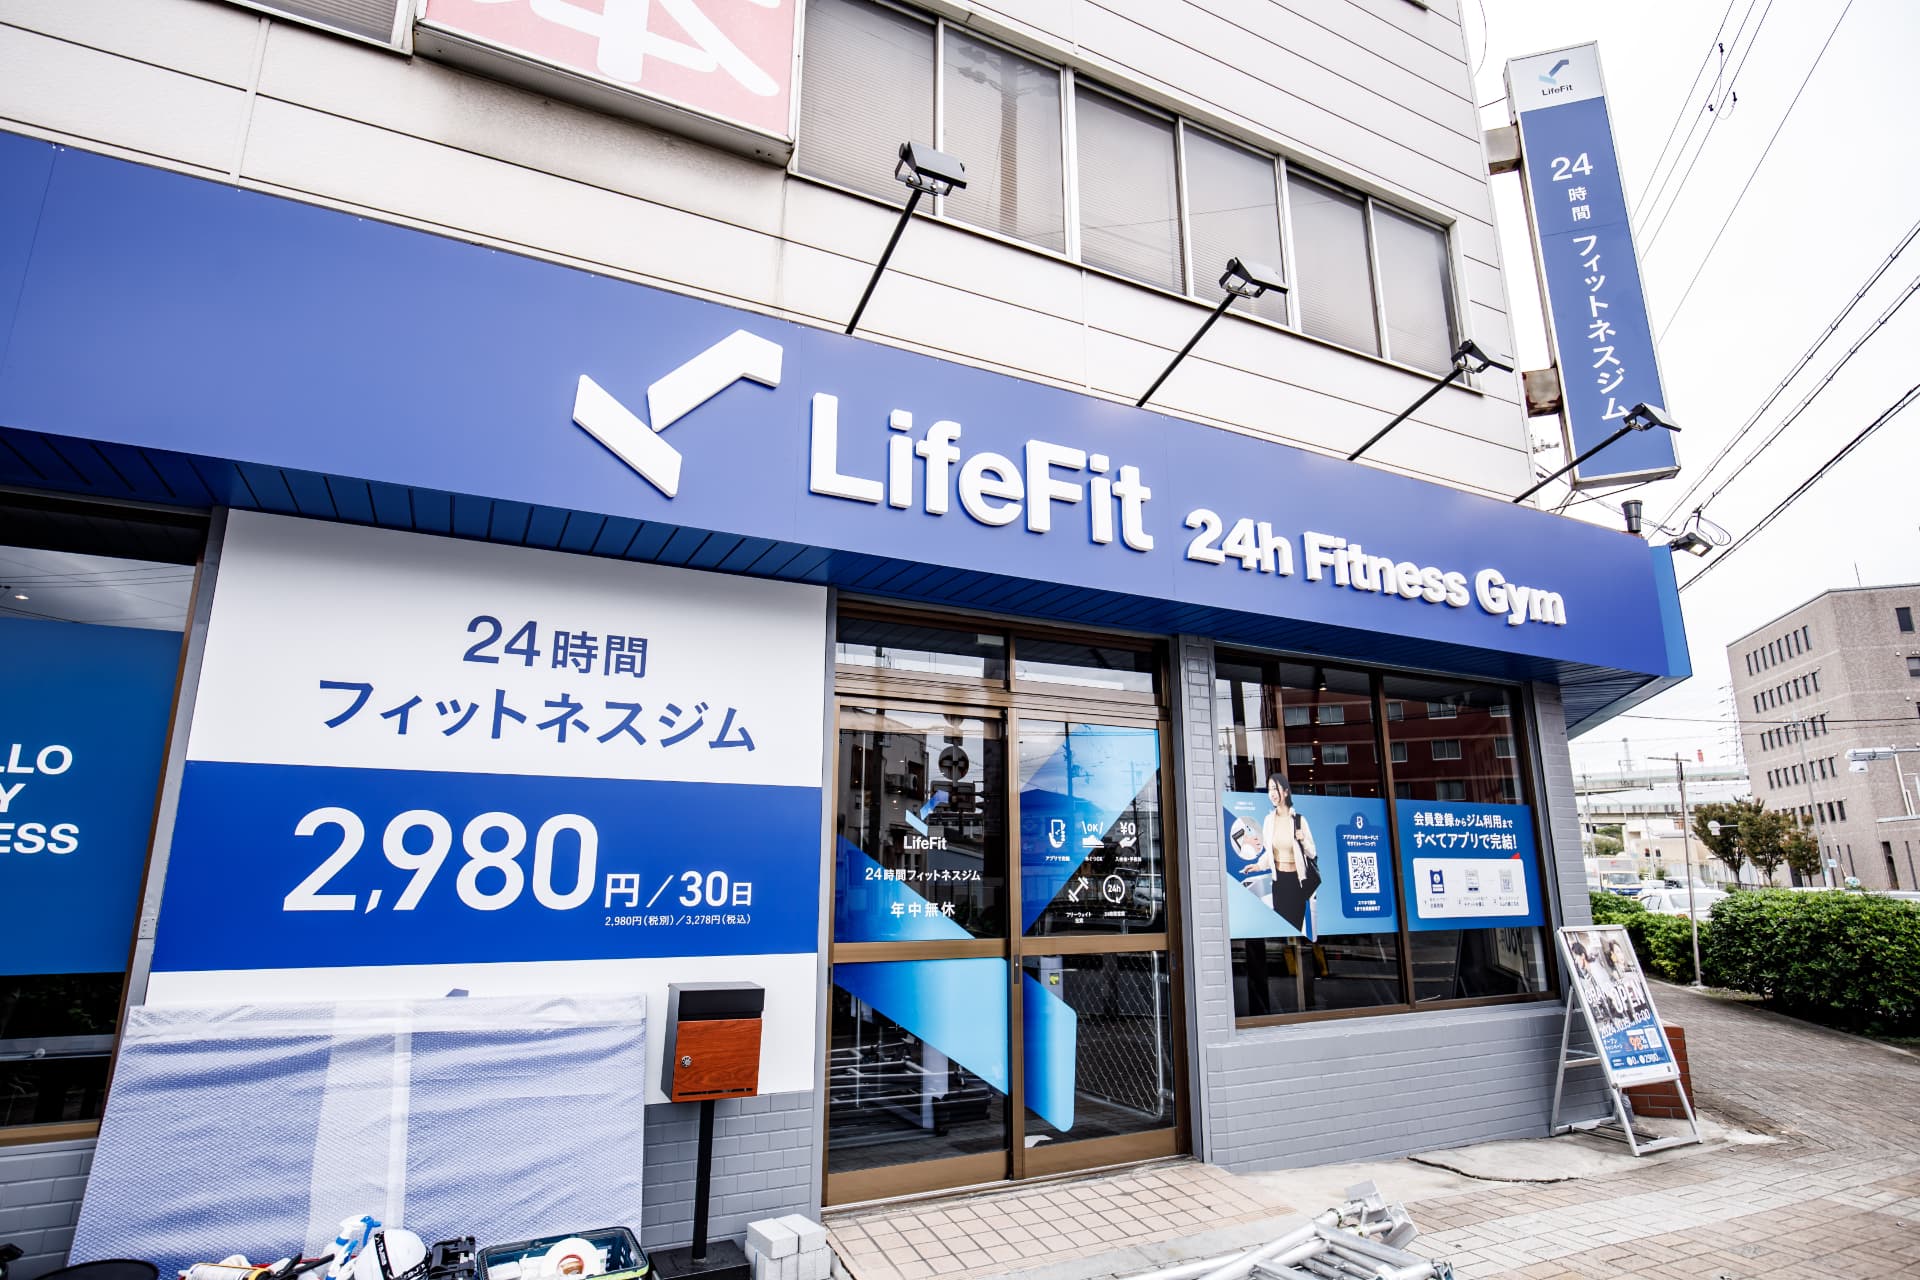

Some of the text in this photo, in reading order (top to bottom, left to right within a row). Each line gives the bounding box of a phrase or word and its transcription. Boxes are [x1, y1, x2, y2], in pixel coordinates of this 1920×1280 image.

[1541, 84, 1574, 96] LifeFit
[810, 392, 1154, 552] LifeFit
[1184, 508, 1567, 626] 24h Fitness Gym
[462, 615, 649, 679] 24時間
[319, 678, 757, 752] フィットネスジム
[0, 743, 73, 775] LO
[1087, 823, 1098, 832] OK
[1413, 811, 1513, 828] 会員登録からジム利用まで
[903, 836, 948, 850] LifeFit
[865, 867, 981, 882] 24時間フィットネスジム
[1107, 884, 1121, 893] 24h
[890, 901, 956, 918] 年中無休
